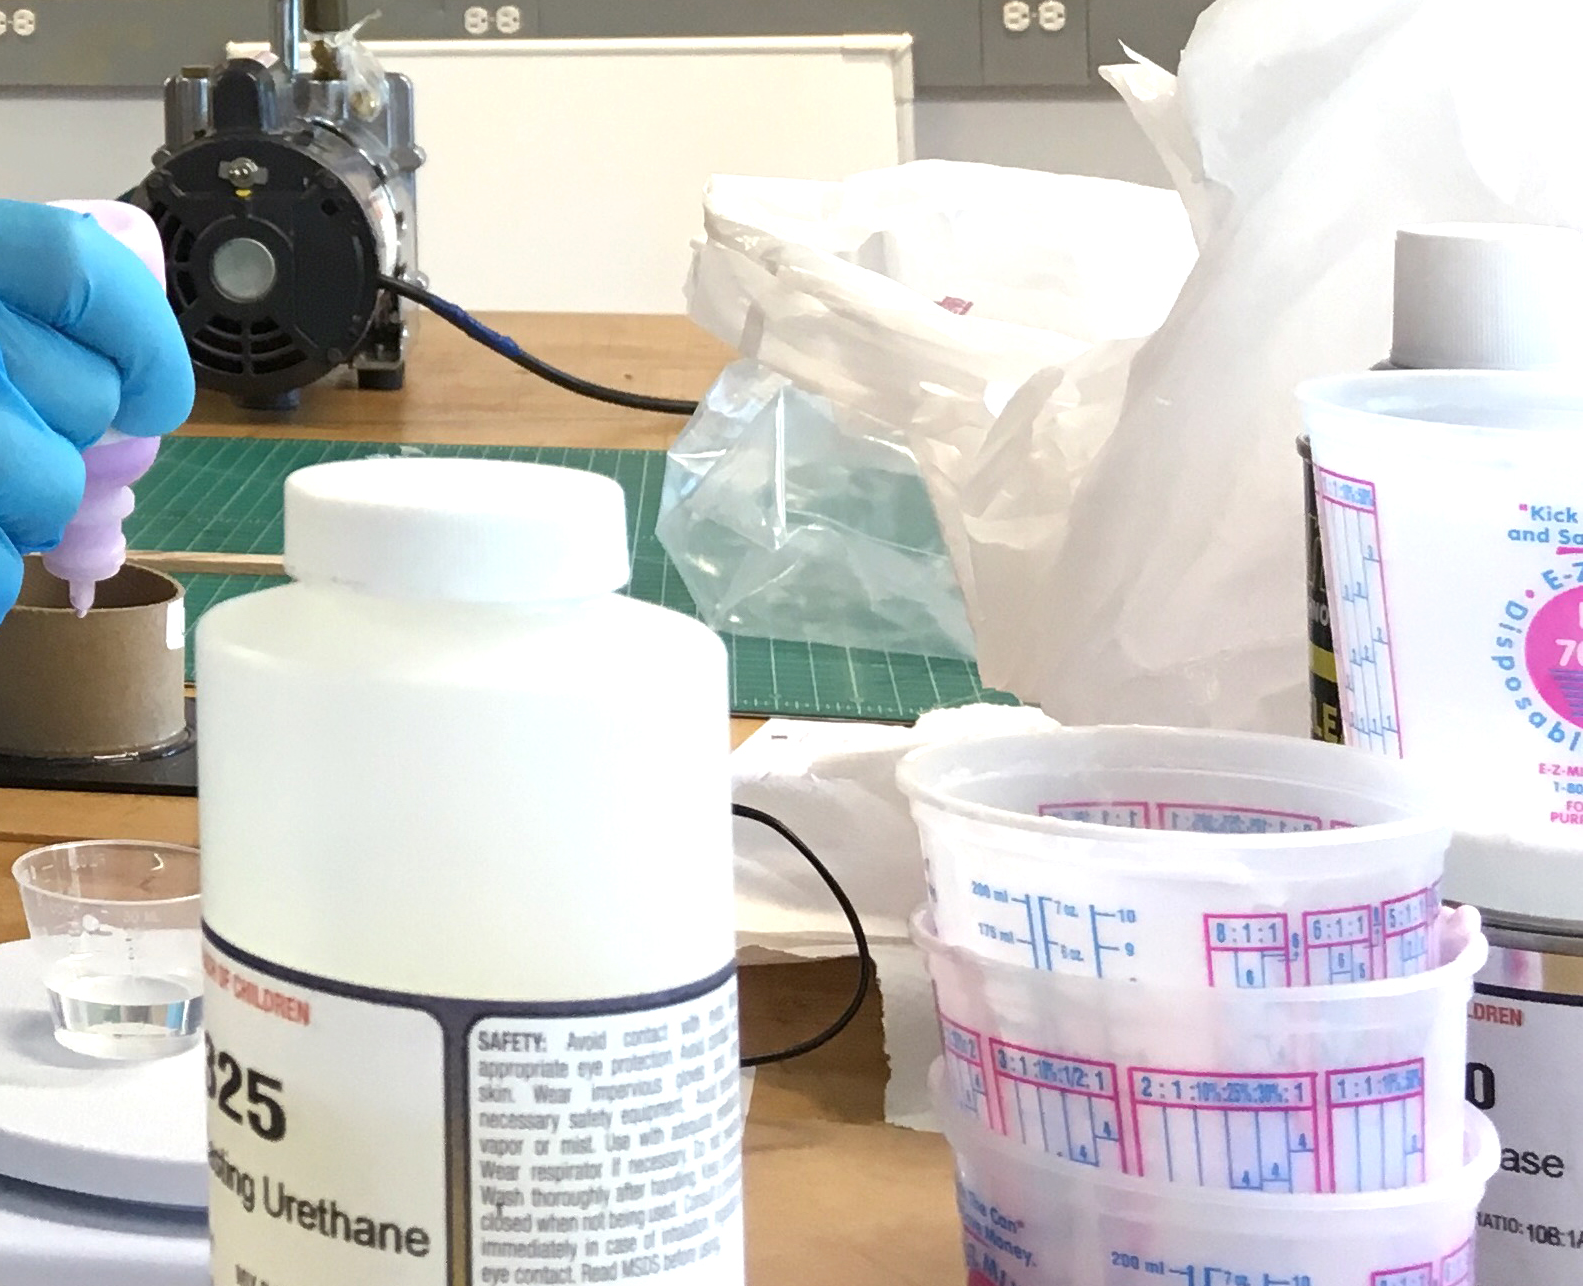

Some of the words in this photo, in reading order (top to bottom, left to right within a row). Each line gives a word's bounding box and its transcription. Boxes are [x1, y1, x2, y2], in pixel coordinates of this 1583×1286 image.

[1507, 527, 1551, 545] and
[1118, 908, 1137, 925] 10
[1124, 941, 1136, 957] 9
[233, 973, 311, 1026] CHILDREN
[1467, 1001, 1523, 1028] DREN
[478, 1031, 548, 1052] SAFETY:
[566, 1031, 607, 1052] Avoid
[478, 1060, 569, 1081] appropriate
[577, 1060, 604, 1081] eye
[478, 1084, 516, 1103] skin.
[534, 1085, 572, 1104] Wear
[479, 1113, 560, 1134] necessary
[569, 1108, 614, 1131] safety
[479, 1138, 524, 1157] vapor
[534, 1139, 550, 1156] or
[479, 1160, 520, 1181] Wear
[479, 1184, 525, 1207] Wash
[531, 1184, 610, 1211] thoroughly
[262, 1174, 431, 1258] Urethane
[537, 1213, 579, 1233] when
[583, 1211, 605, 1232] not
[609, 1209, 646, 1230] being
[481, 1240, 578, 1263] immediately
[585, 1239, 600, 1257] in
[605, 1236, 637, 1256] case
[642, 1229, 656, 1251] of
[481, 1266, 511, 1286] eye
[514, 1264, 577, 1285] contact.
[580, 1261, 618, 1283] Read
[621, 1253, 661, 1278] MSDS
[1144, 1260, 1166, 1276] ml
